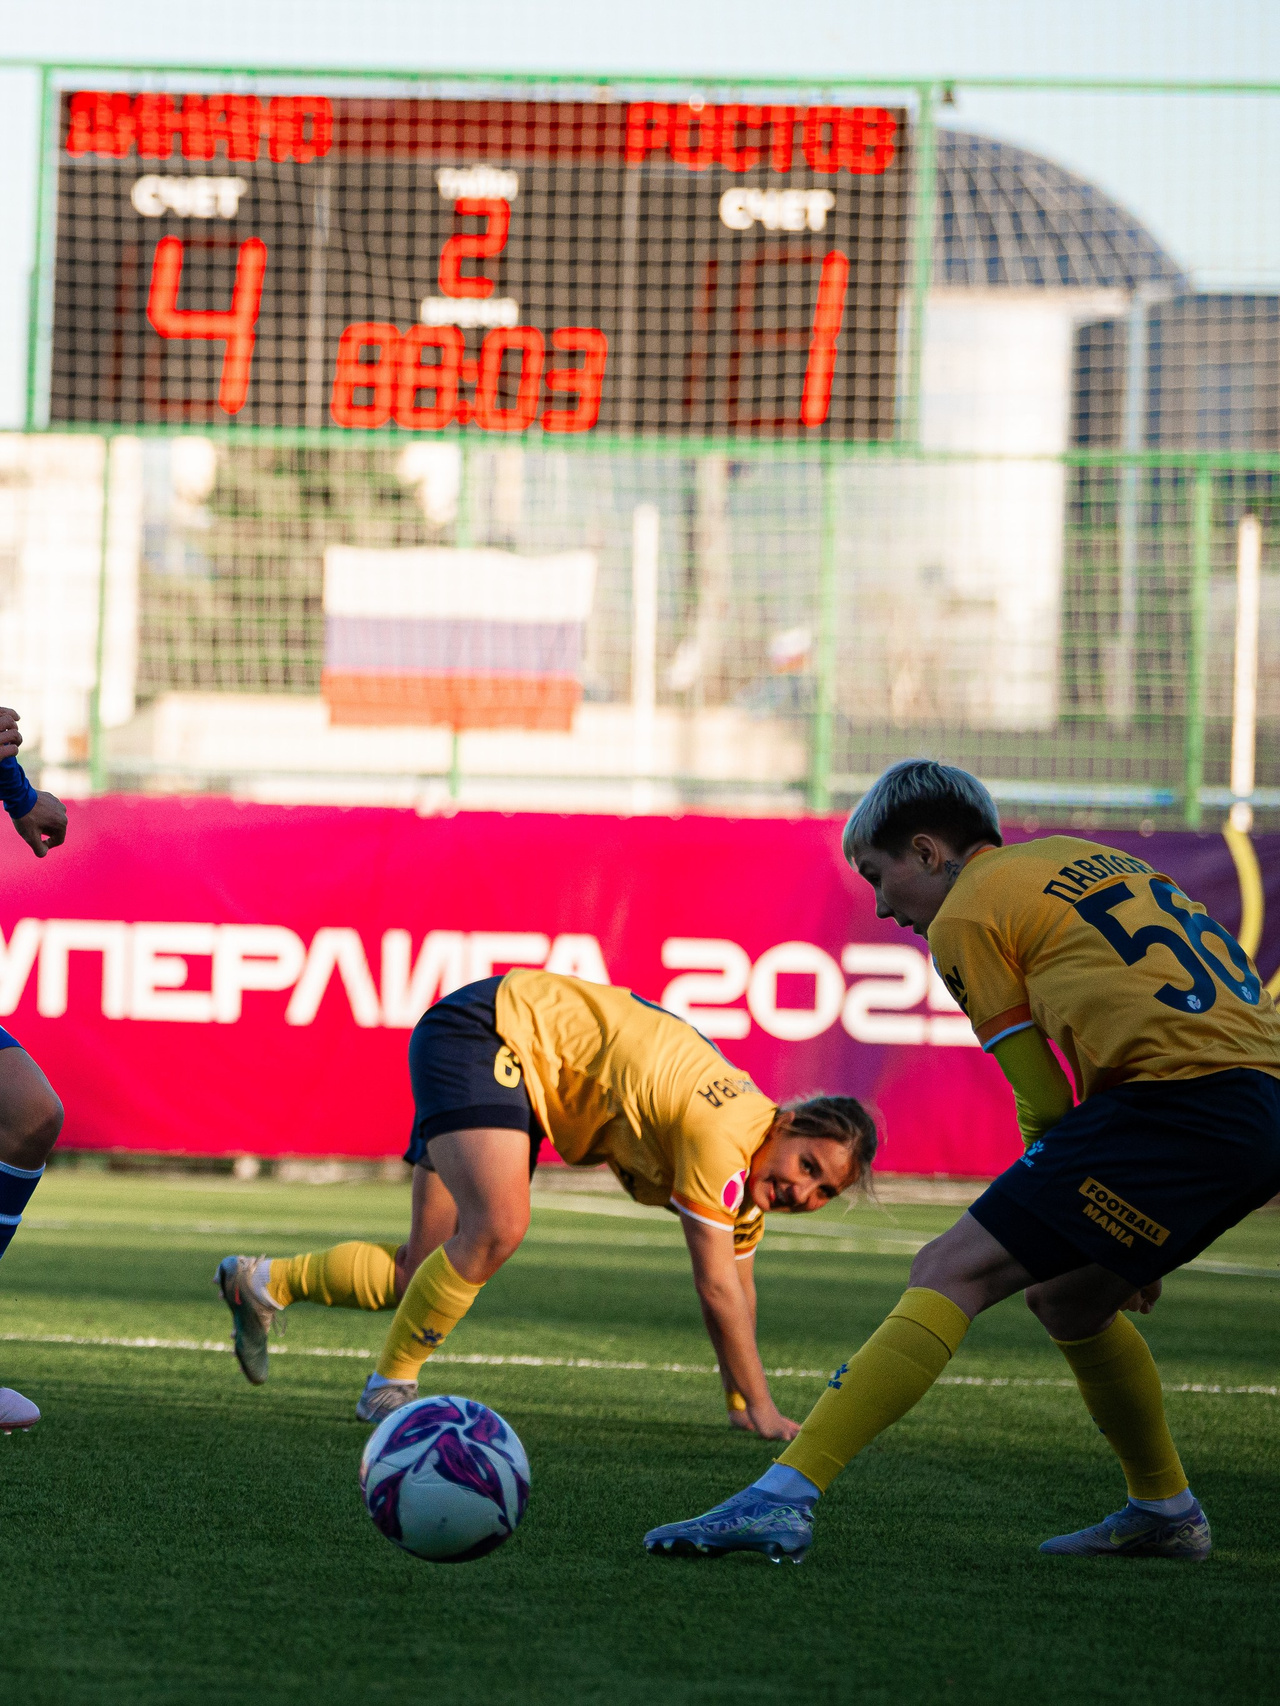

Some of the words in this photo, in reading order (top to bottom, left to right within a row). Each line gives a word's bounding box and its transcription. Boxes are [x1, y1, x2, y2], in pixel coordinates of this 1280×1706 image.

[624, 102, 897, 175] РОСТОВ
[438, 196, 511, 299] 2
[147, 236, 267, 415] 4
[800, 249, 850, 427] 1
[330, 322, 608, 433] 88:03
[1043, 854, 1159, 905] ПАВЛОВ
[1073, 878, 1260, 1014] 56
[1082, 1203, 1135, 1248] MANIA
[1086, 1183, 1164, 1241] FOOTBALL
